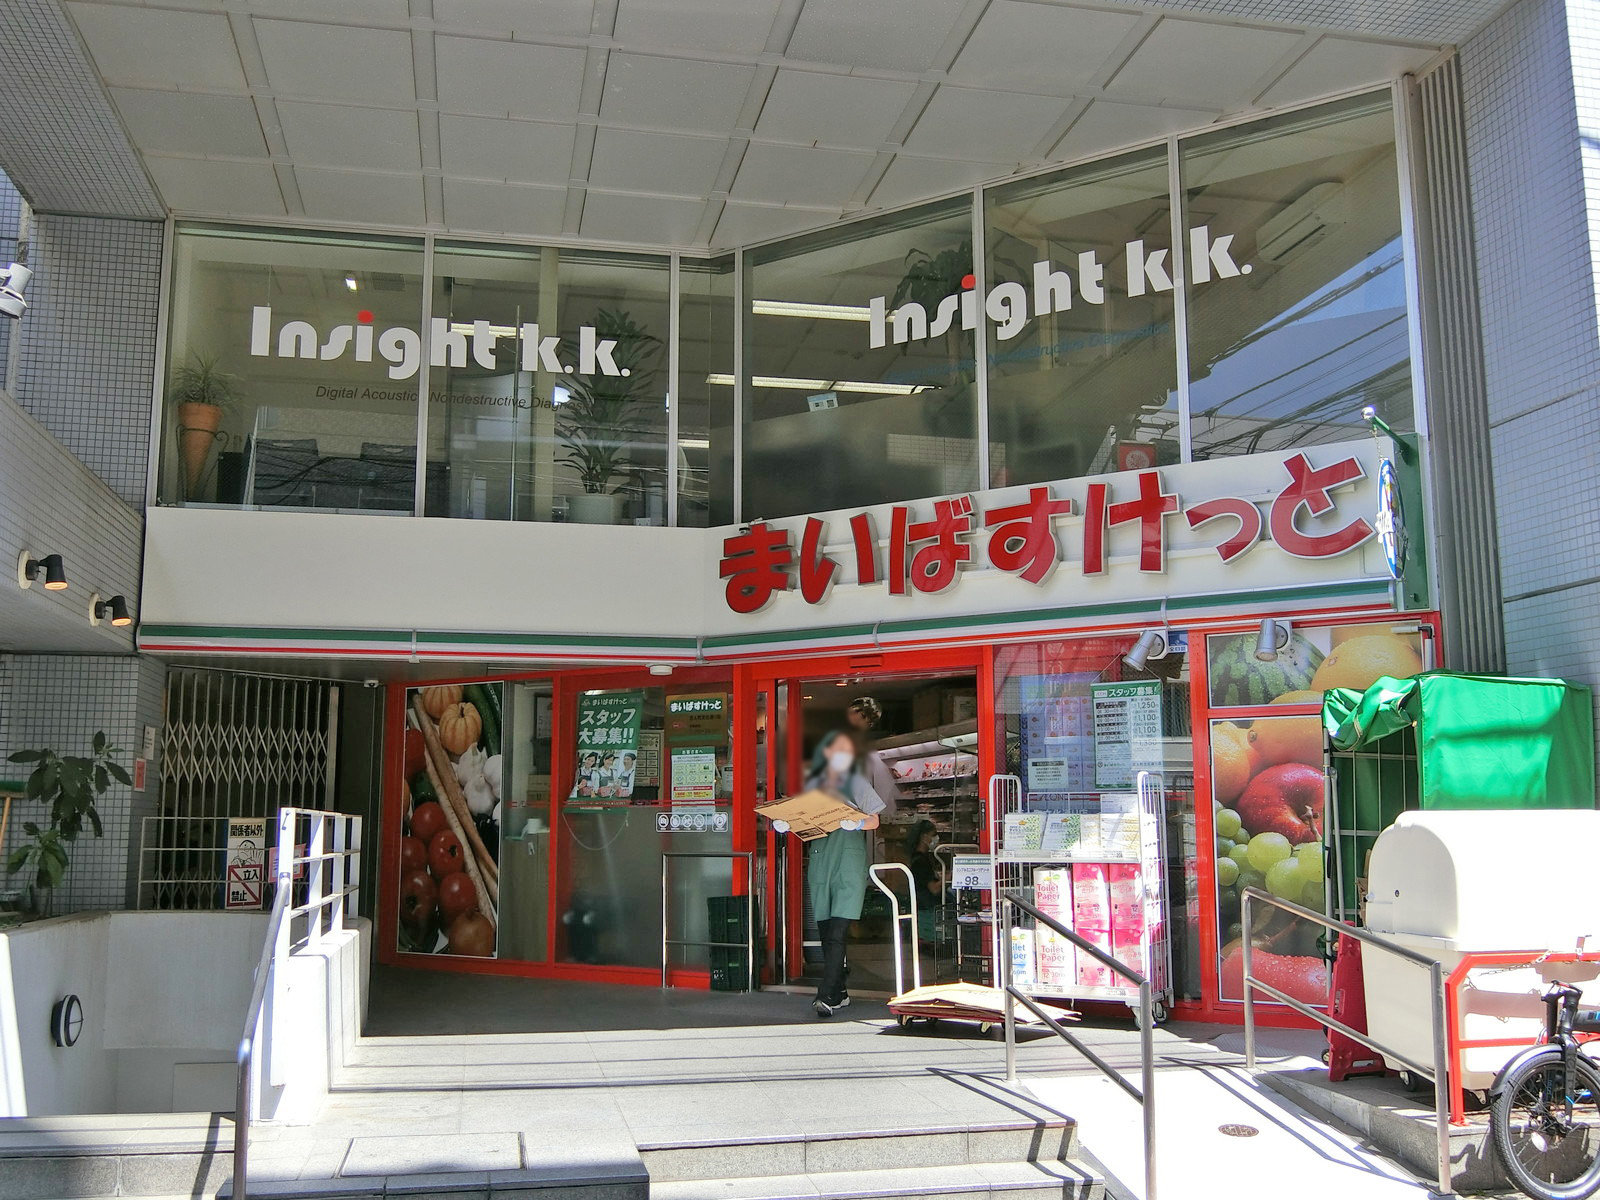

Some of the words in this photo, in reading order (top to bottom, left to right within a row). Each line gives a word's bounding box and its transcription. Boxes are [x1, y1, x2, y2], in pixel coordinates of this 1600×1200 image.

[869, 250, 1104, 349] Insight
[250, 306, 497, 381] Insight
[315, 385, 358, 401] Digital
[429, 391, 526, 408] Nondestructive
[719, 452, 1378, 615] まいばすけっと
[592, 697, 628, 706] まいばすけっと
[670, 699, 722, 712] まいばすけっと
[579, 708, 636, 726] スタッフ
[578, 727, 635, 745] 大募集!!
[230, 824, 263, 838] 関係者以外
[243, 869, 259, 880] 立入
[964, 875, 979, 886] 98
[1037, 883, 1059, 891] Toilet
[231, 890, 248, 902] 禁止
[1037, 892, 1060, 901] Paper
[1012, 943, 1026, 951] ilet
[1041, 945, 1064, 954] Toilet
[1041, 953, 1065, 963] Paper
